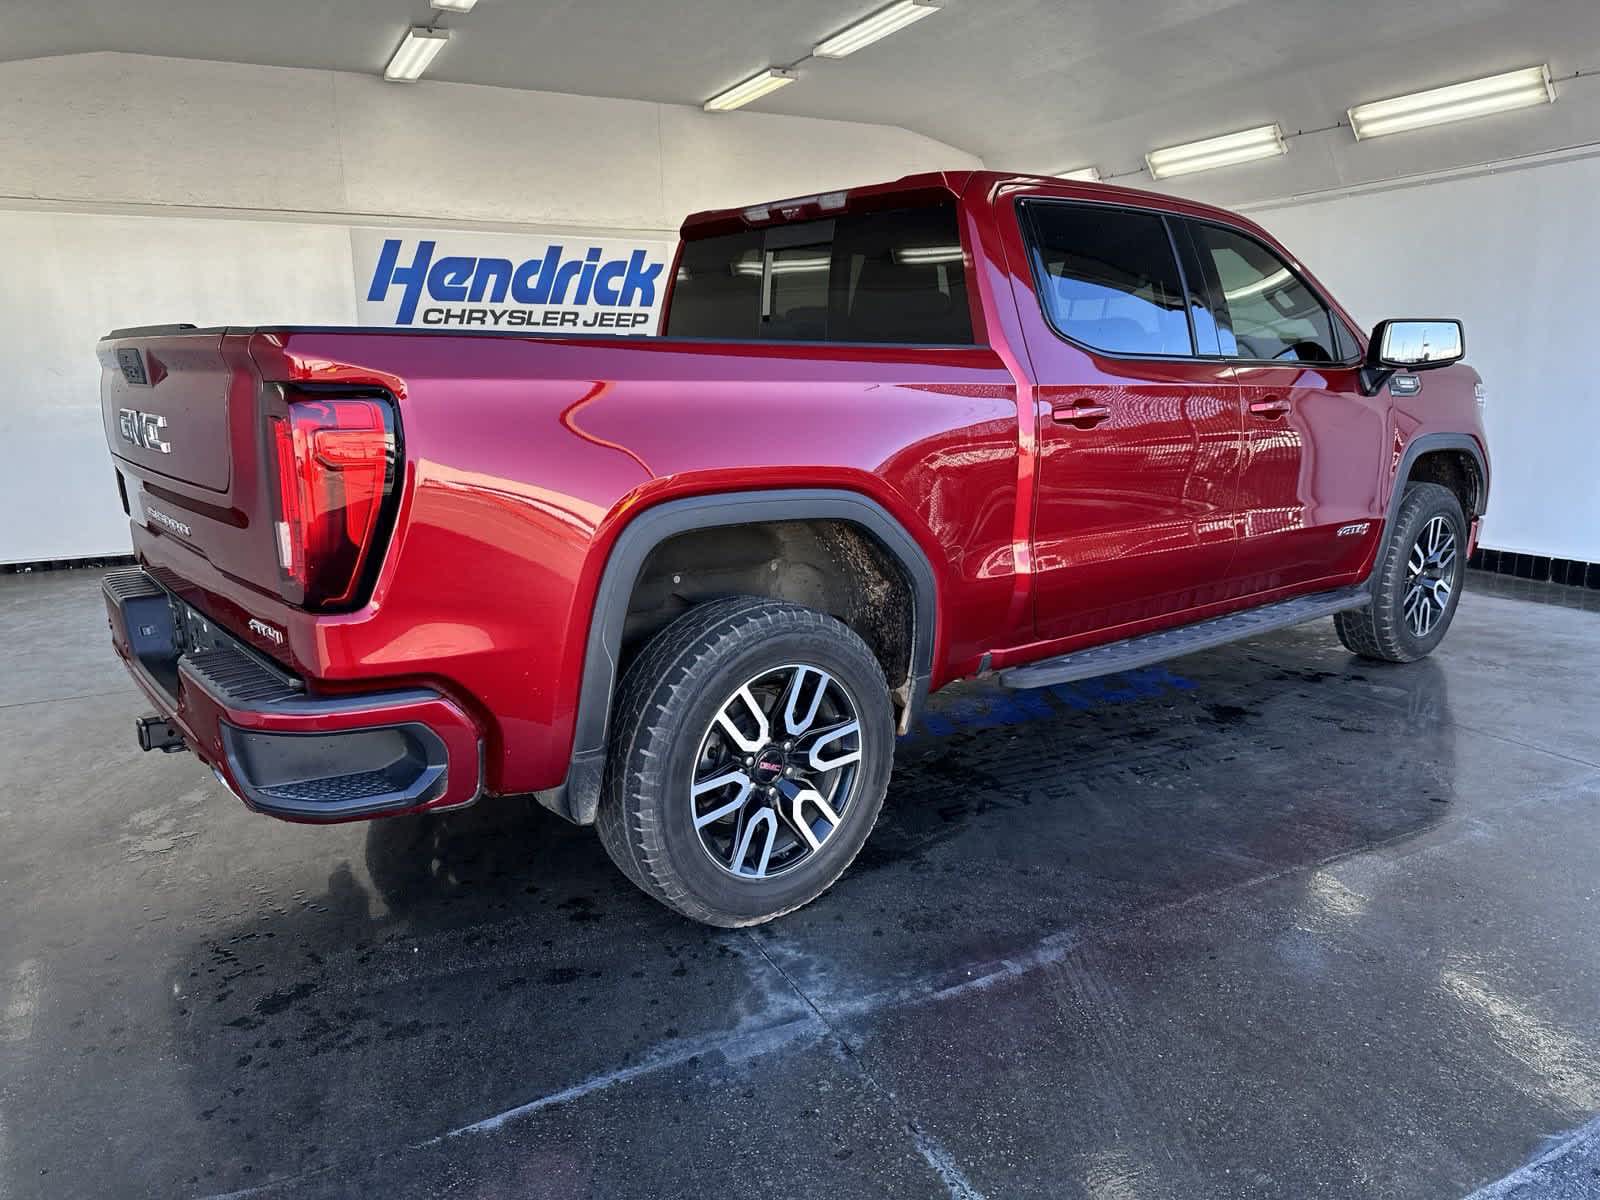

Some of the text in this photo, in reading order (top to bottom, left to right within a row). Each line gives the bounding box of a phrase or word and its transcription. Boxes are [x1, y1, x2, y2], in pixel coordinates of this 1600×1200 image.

[367, 239, 665, 325] Hendrick
[422, 307, 649, 328] CHRYSLER JEEP
[119, 408, 171, 454] GMC
